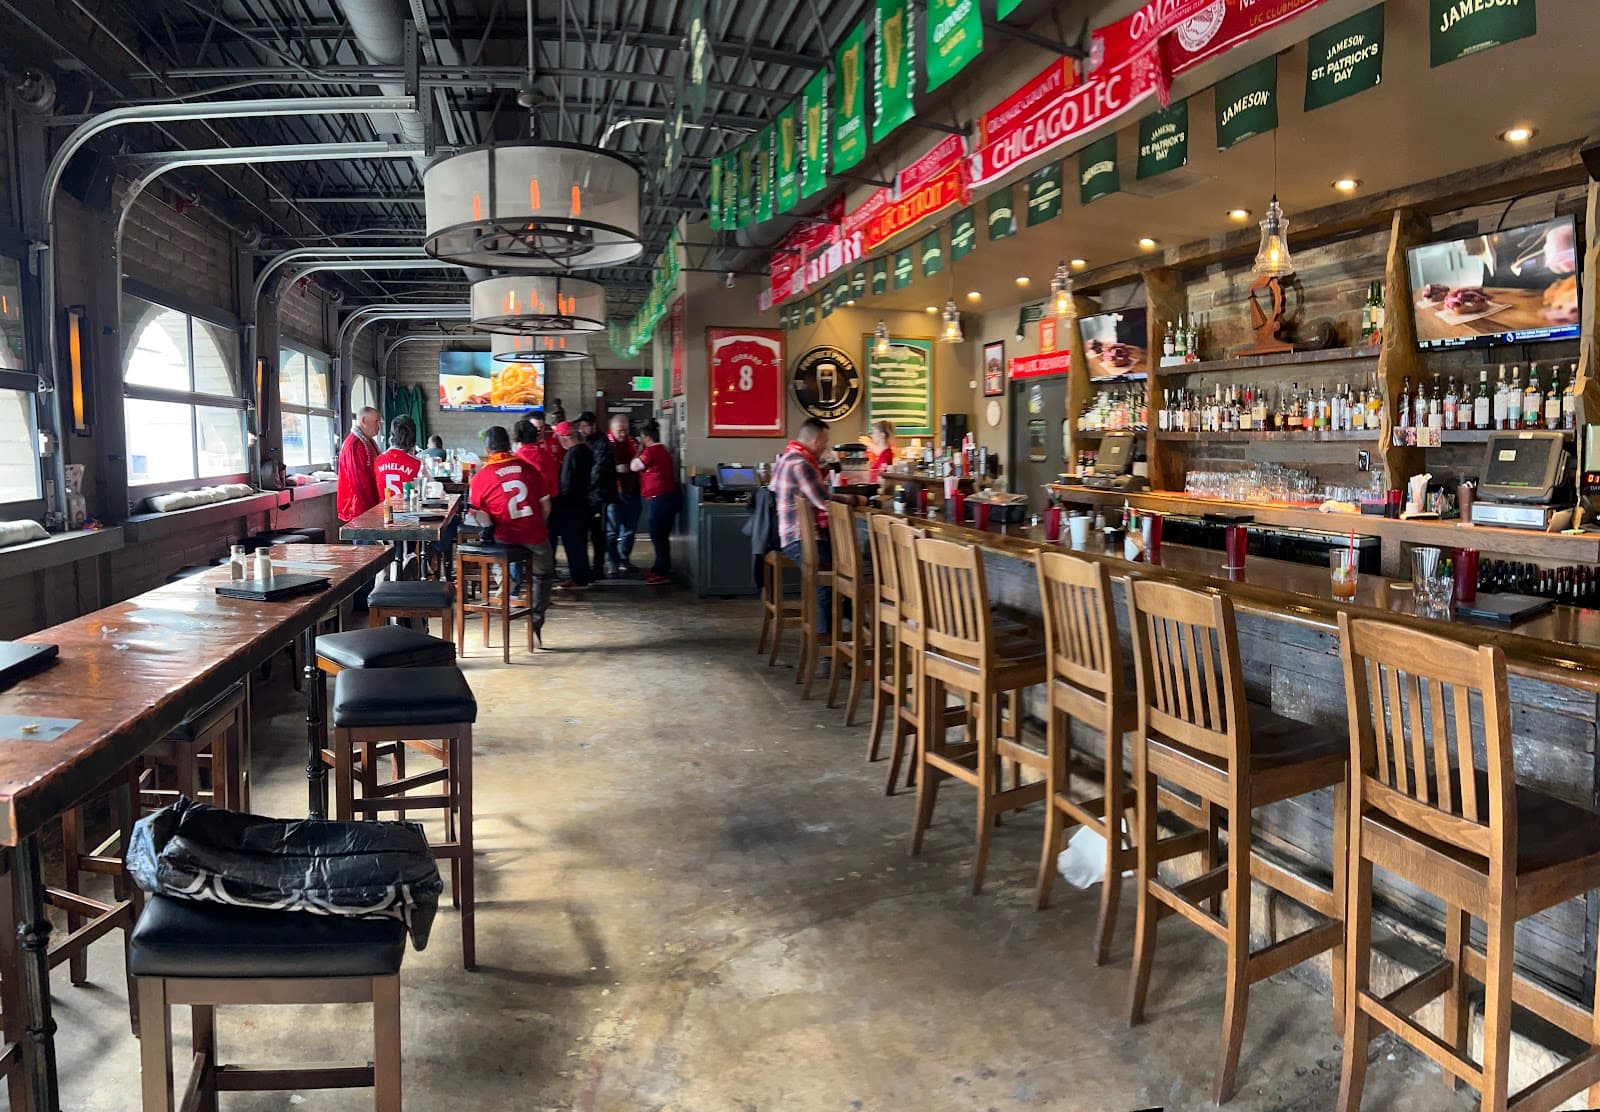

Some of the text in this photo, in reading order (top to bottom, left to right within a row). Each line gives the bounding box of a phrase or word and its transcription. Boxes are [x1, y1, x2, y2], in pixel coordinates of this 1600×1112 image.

[1130, 0, 1188, 39] OMA
[1440, 0, 1519, 32] JAME
[1326, 34, 1364, 60] JAMESON
[1311, 43, 1378, 80] ST. PATRICK'S
[1333, 66, 1354, 84] DAY
[1221, 90, 1268, 126] JAMESON
[991, 100, 1079, 169] CHICAGO
[1083, 74, 1122, 124] LFC
[1151, 123, 1176, 141] JAMESON
[1150, 132, 1185, 153] PATRICK'S
[1155, 149, 1169, 161] DAY
[739, 365, 753, 391] 8
[378, 462, 413, 475] WHELAN
[385, 473, 401, 498] 5
[502, 480, 534, 519] 2
